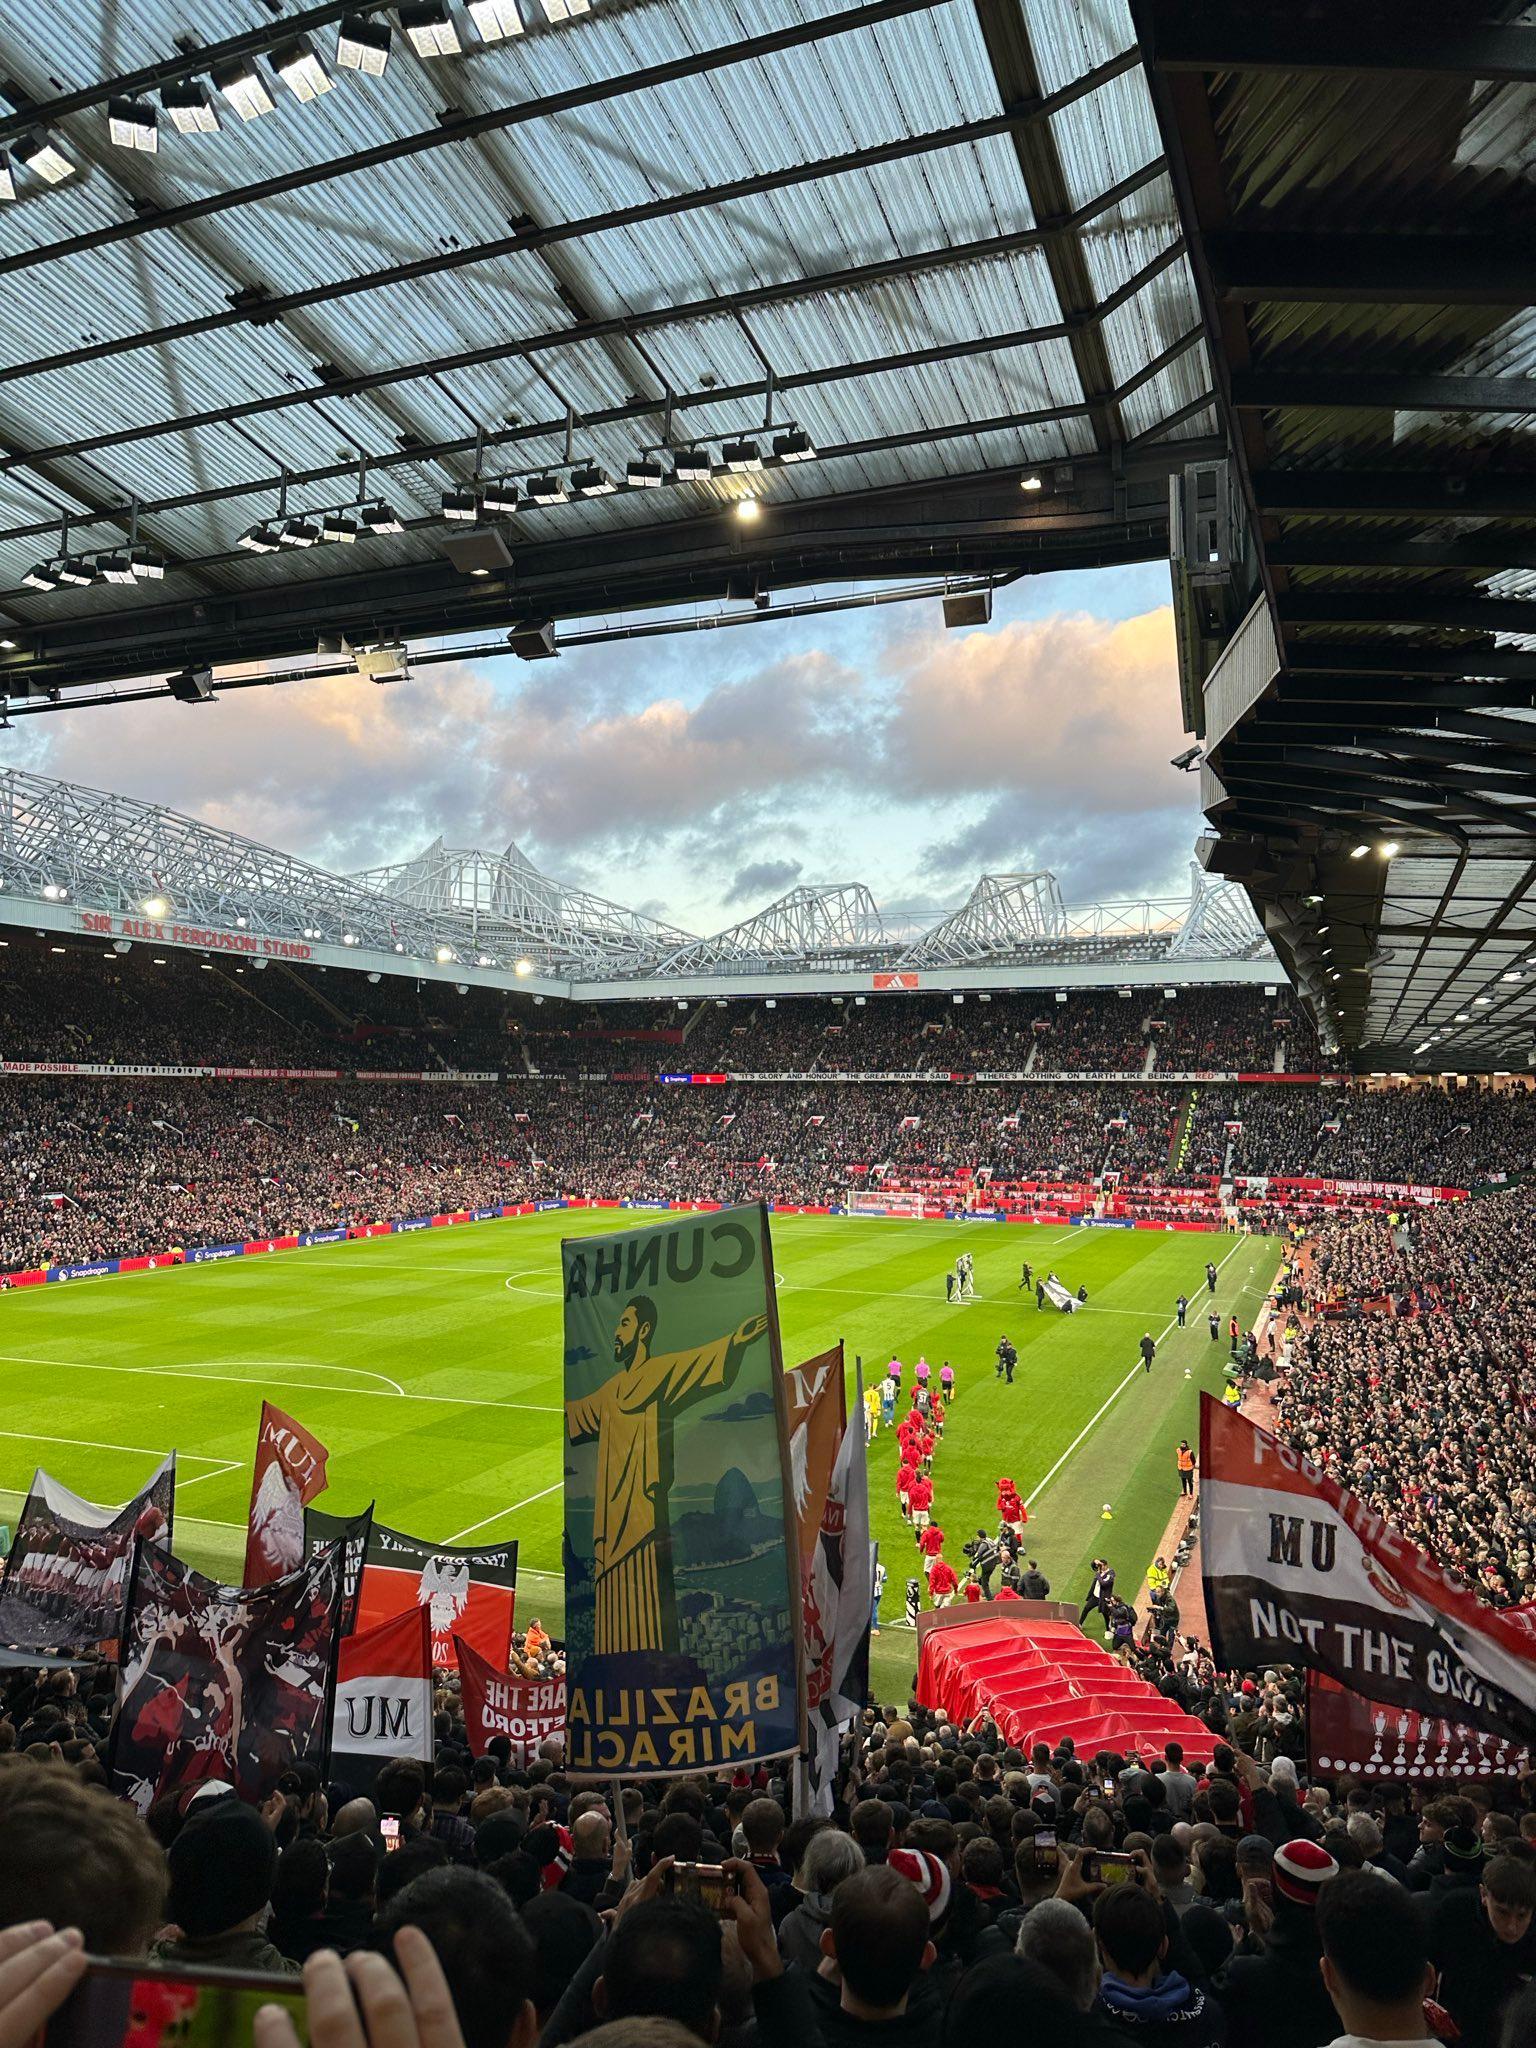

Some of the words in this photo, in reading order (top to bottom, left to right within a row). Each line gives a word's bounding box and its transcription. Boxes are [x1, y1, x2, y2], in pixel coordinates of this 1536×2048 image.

[82, 913, 112, 932] SIR
[122, 919, 164, 940] ALEX
[173, 926, 257, 952] FERGUSON
[263, 937, 312, 959] STAND
[3, 1062, 32, 1071] MADE
[217, 1068, 233, 1076] EVERY
[253, 1068, 262, 1077] ONE
[264, 1069, 270, 1077] OF
[271, 1069, 278, 1077] US
[579, 1073, 588, 1081] SIR
[589, 1073, 607, 1081] BOBBY
[1336, 1181, 1372, 1193] DOWNLOAD
[1373, 1183, 1384, 1194] THE
[1410, 1186, 1421, 1196] APP
[314, 1234, 340, 1244] Snapdragon
[204, 1249, 236, 1260] Snapdragon
[71, 1267, 109, 1278] Snapdragon
[1267, 1513, 1338, 1573] MU
[1250, 1599, 1325, 1655] NOT
[1334, 1624, 1415, 1682] THE
